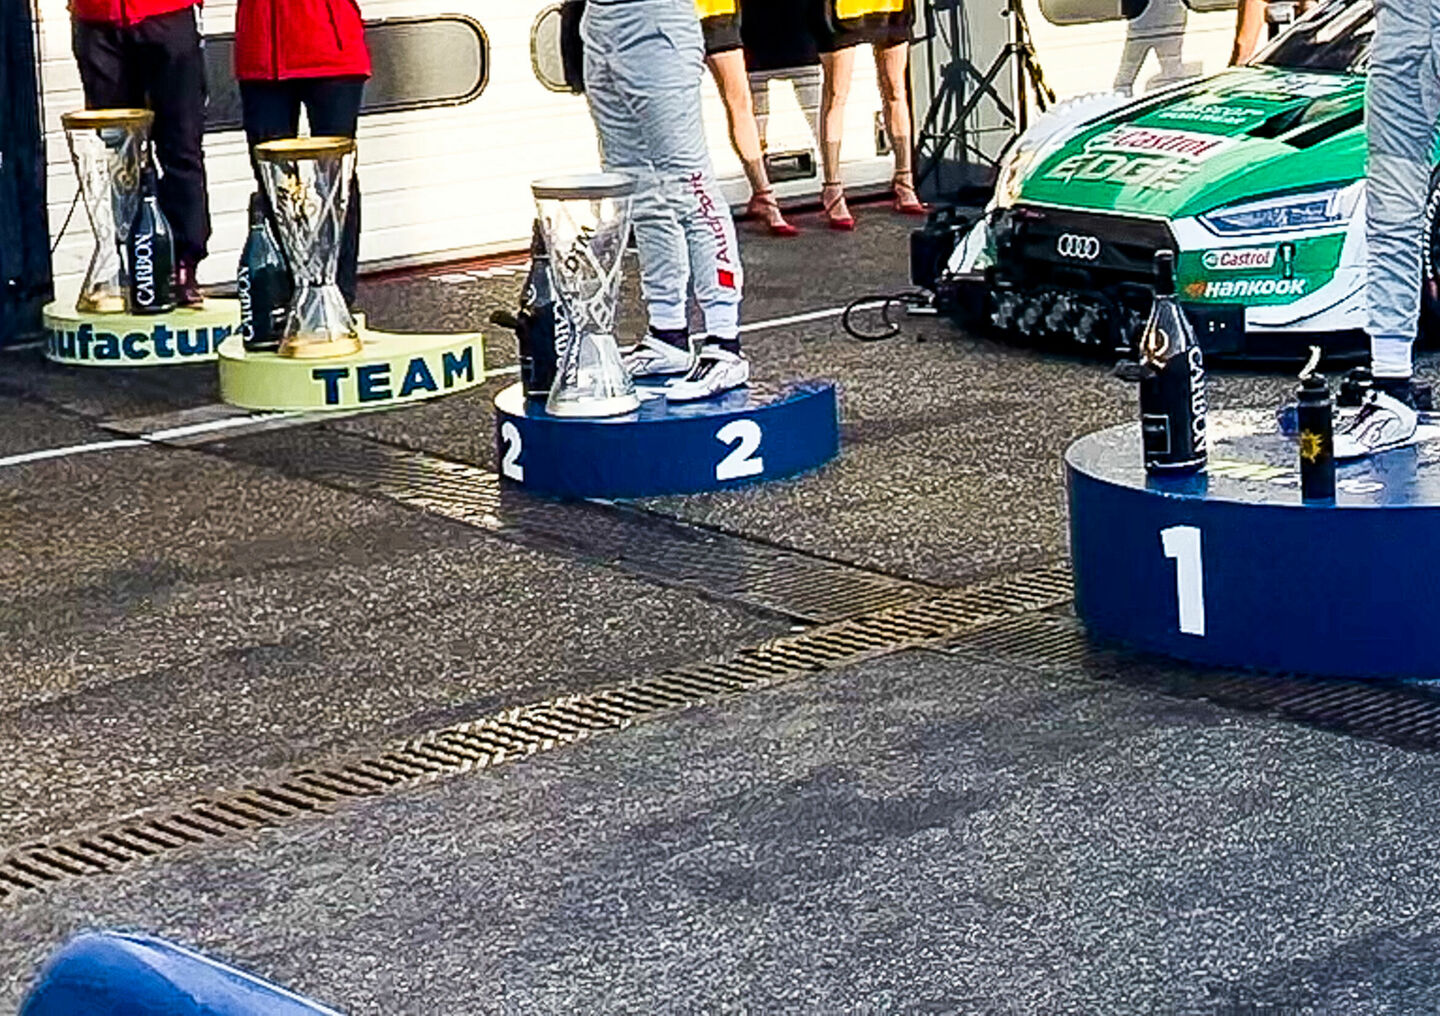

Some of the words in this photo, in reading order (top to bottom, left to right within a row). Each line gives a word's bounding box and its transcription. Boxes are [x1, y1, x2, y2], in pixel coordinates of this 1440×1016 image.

[1219, 250, 1270, 267] Castrol
[312, 345, 476, 406] TEAM
[501, 421, 524, 482] 2
[715, 418, 764, 481] 2
[1160, 525, 1206, 636] 1
